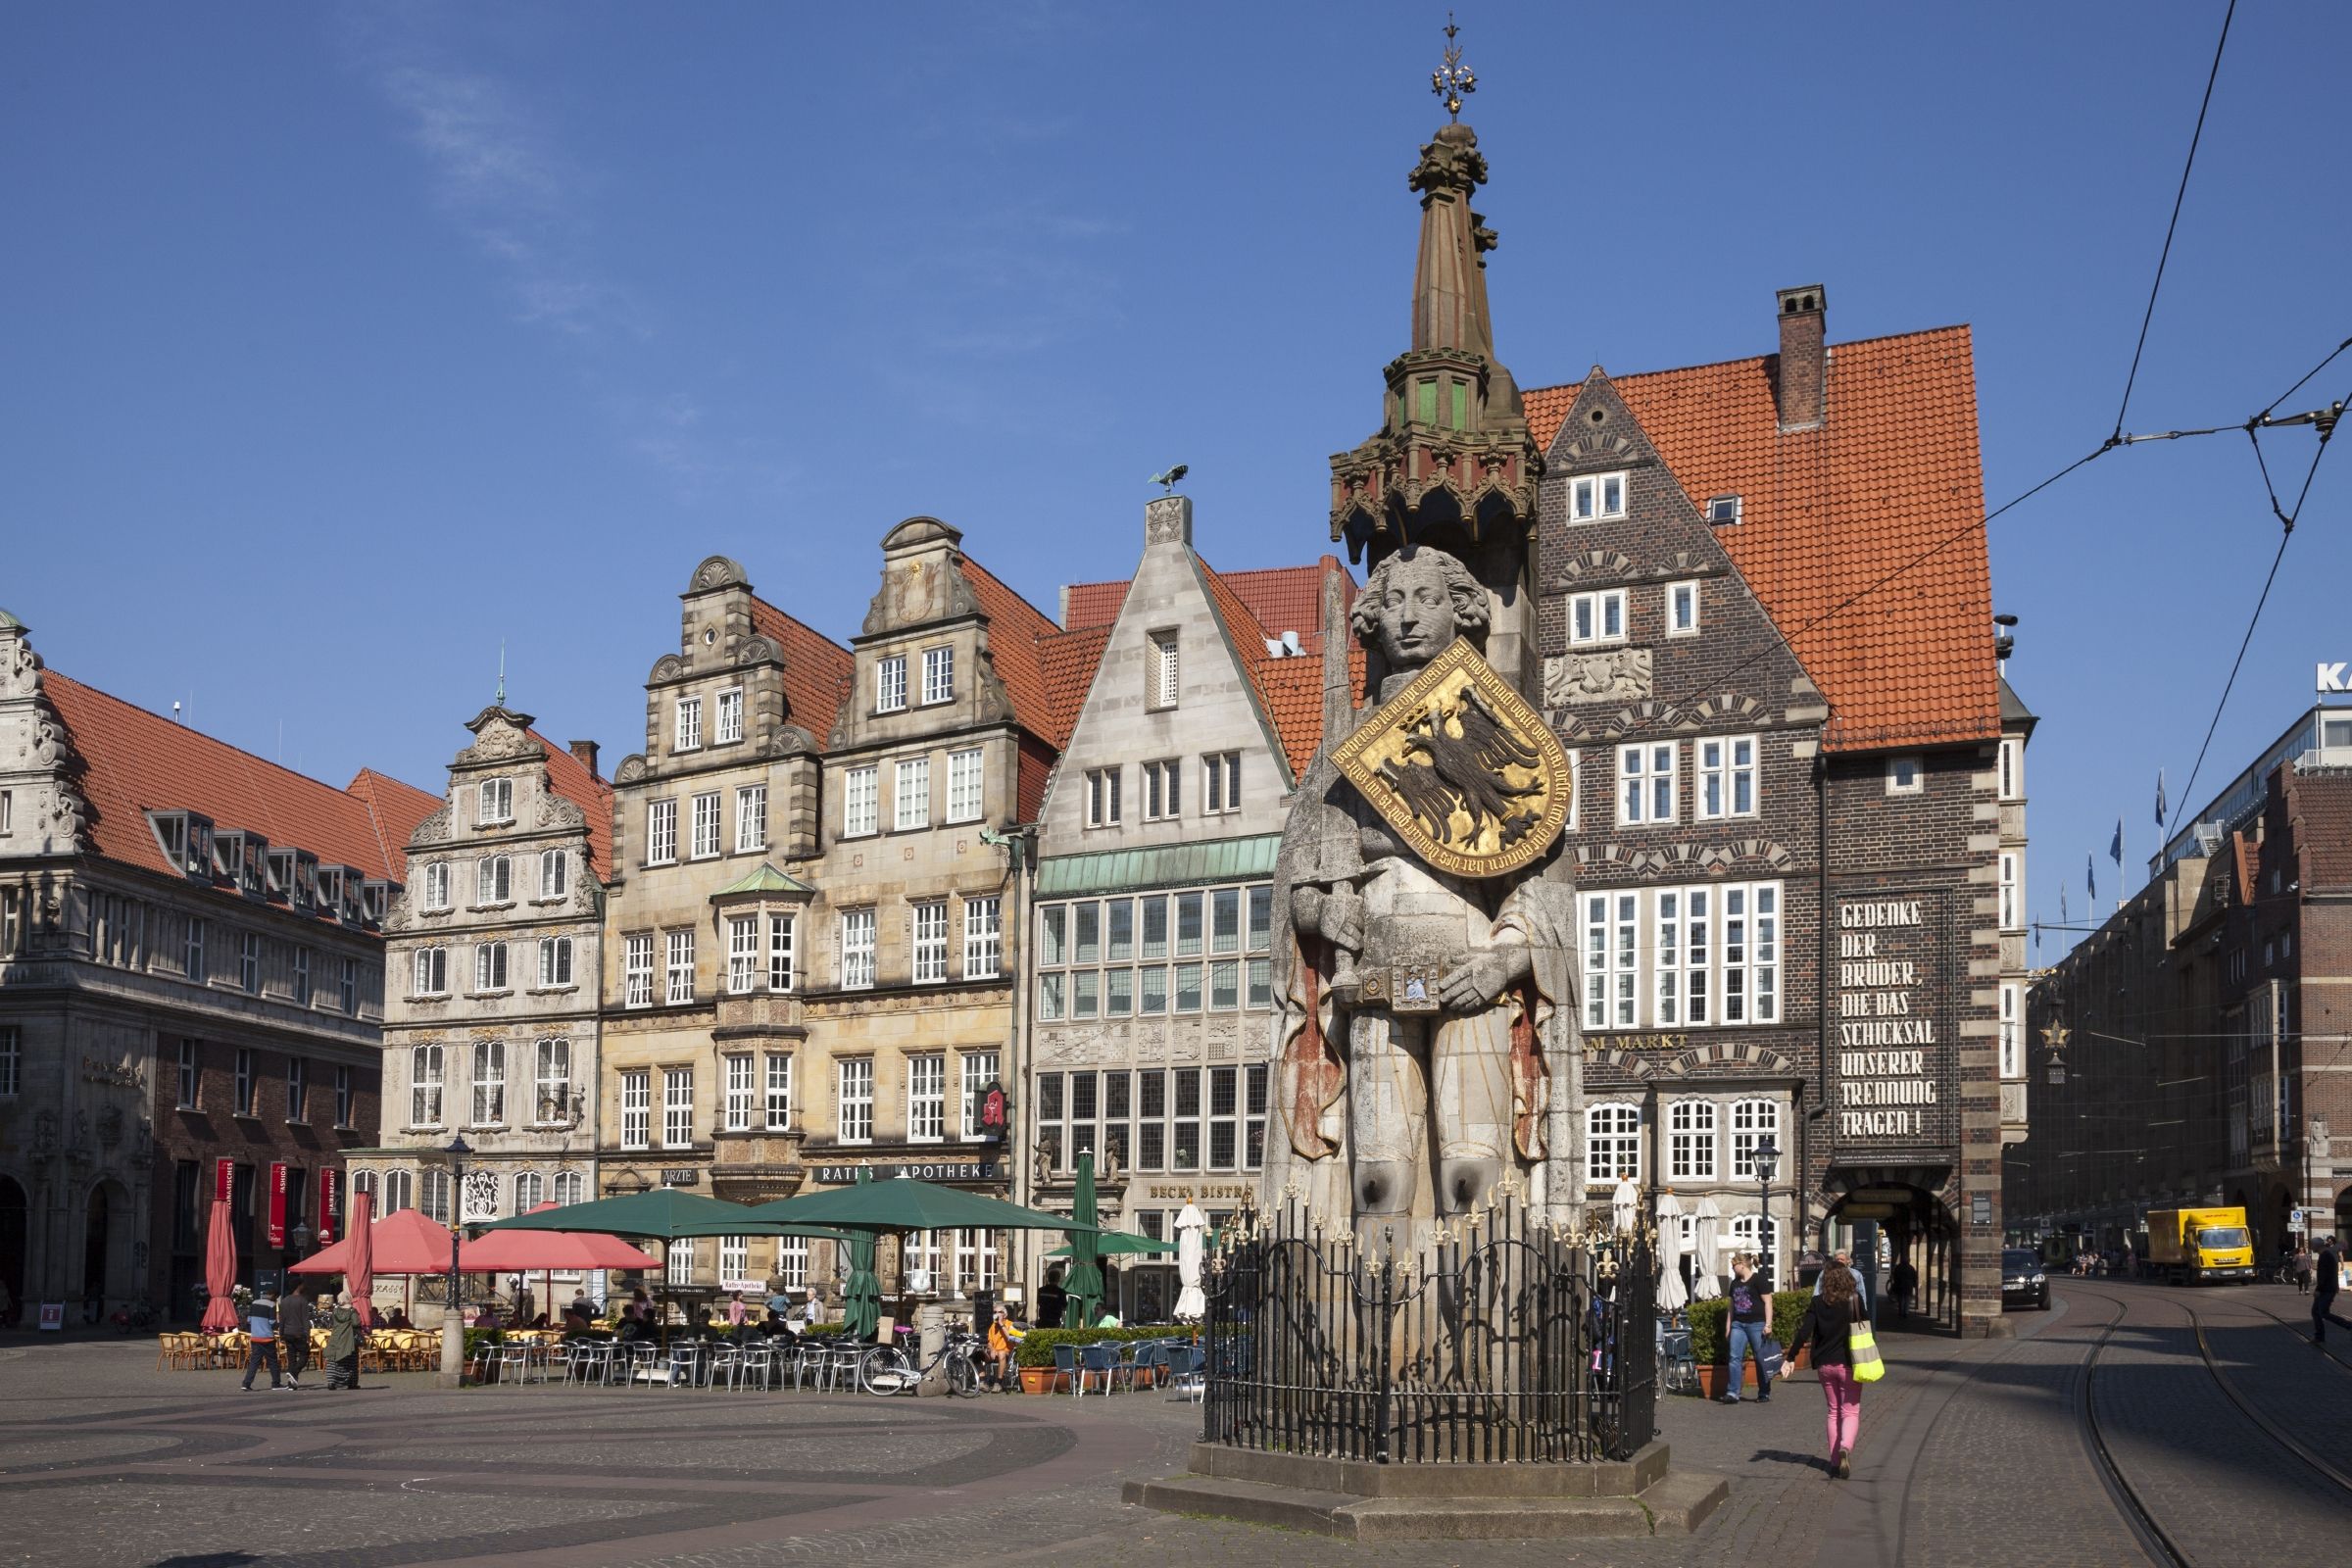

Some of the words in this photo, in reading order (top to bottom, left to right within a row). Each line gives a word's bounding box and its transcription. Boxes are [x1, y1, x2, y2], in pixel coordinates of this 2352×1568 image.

[2318, 662, 2352, 691] K
[1841, 902, 1921, 927] GEDENKE
[1841, 934, 1876, 957] DER
[1841, 959, 1923, 987] BRÜDER,
[1841, 993, 1870, 1016] DIE
[1877, 992, 1909, 1015] DAS
[1615, 1034, 1688, 1050] MARKT
[1840, 1020, 1936, 1046] SCHICKSAL
[1841, 1051, 1923, 1076] UNSERER
[1841, 1081, 1936, 1104] TRENNUNG
[1841, 1111, 1908, 1135] TRAGEN
[663, 1169, 692, 1182] ÄRZTE
[901, 1165, 992, 1179] APOTHEKE
